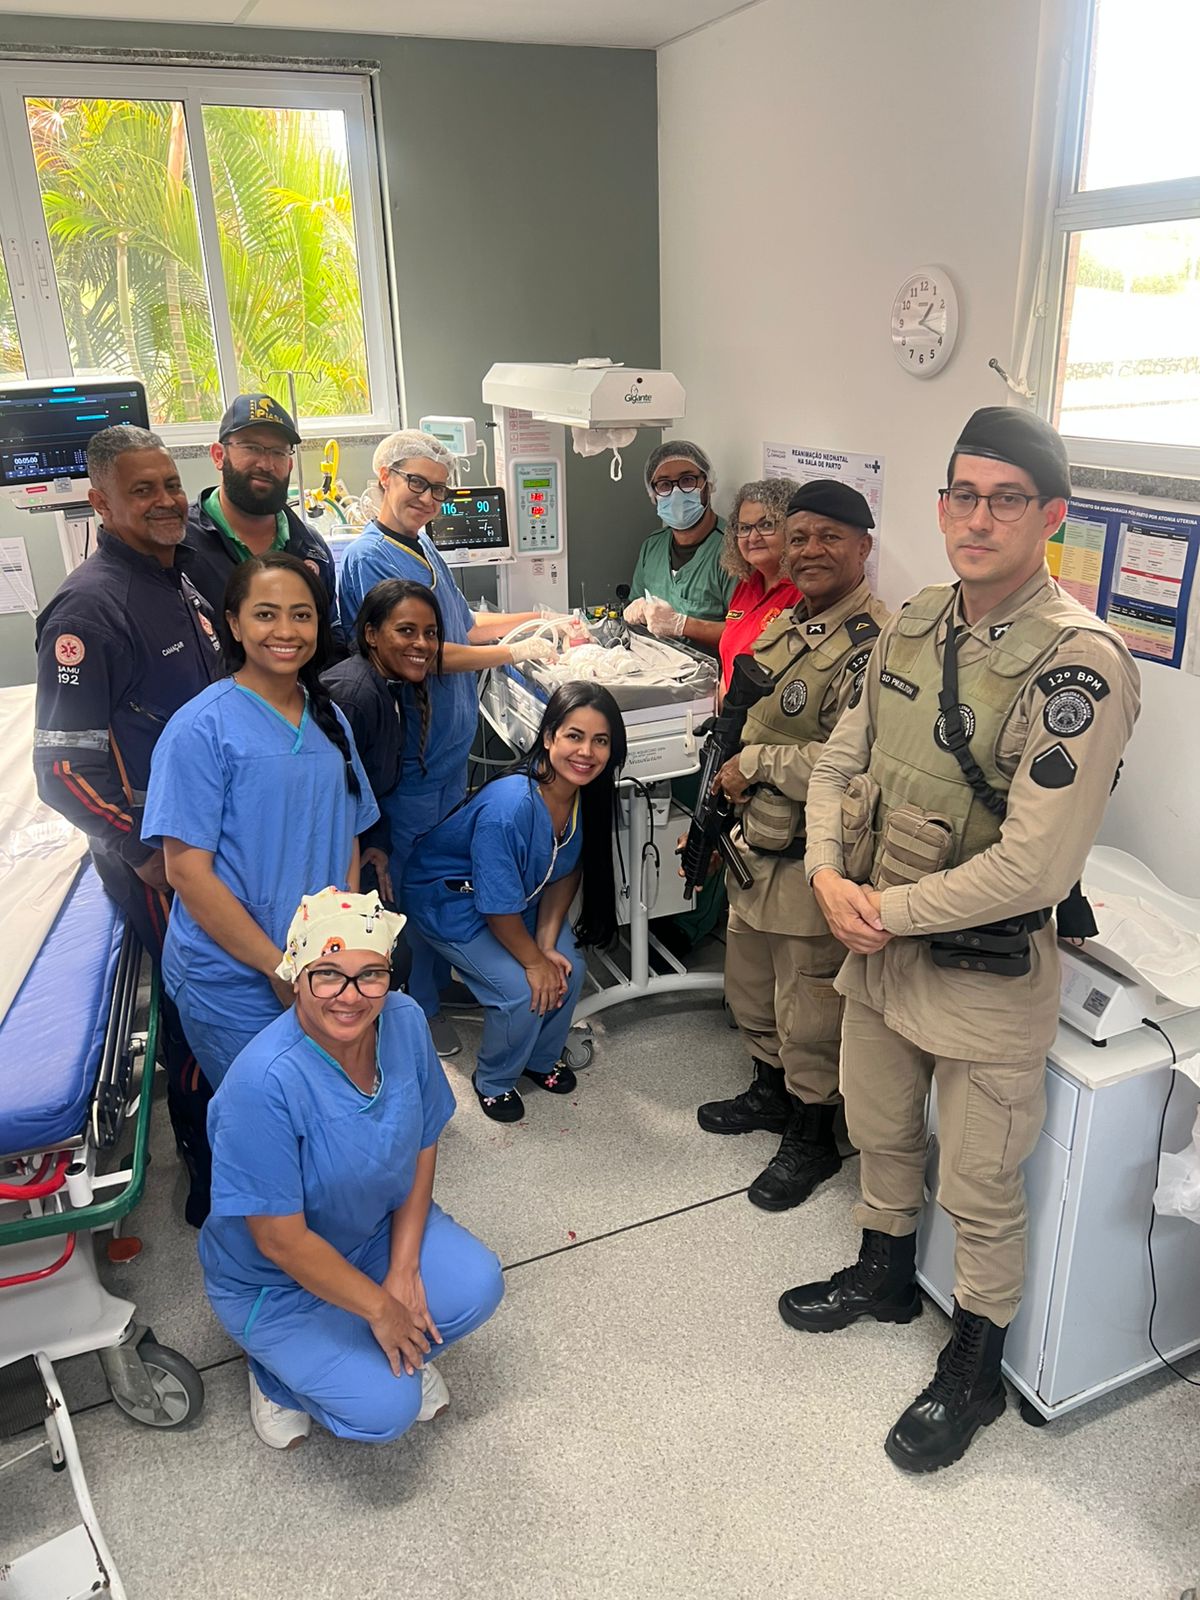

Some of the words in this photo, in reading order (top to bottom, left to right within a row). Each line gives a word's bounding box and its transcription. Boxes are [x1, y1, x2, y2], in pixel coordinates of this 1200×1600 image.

[920, 281, 929, 292] 12
[933, 286, 937, 296] 1
[910, 288, 918, 298] 11
[902, 300, 911, 311] 10
[940, 299, 945, 309] 2
[899, 319, 904, 329] 9
[937, 336, 943, 347] 4
[909, 349, 915, 359] 7
[919, 354, 924, 364] 6
[930, 349, 935, 359] 5
[624, 393, 652, 405] Gigante
[823, 453, 848, 463] NEONATAL
[818, 460, 825, 468] DE
[826, 461, 841, 470] PARTO
[441, 502, 458, 515] 116
[476, 500, 490, 513] 90
[1176, 517, 1198, 526] UTERINA
[57, 673, 80, 685] 192
[881, 674, 891, 683] SD
[1076, 671, 1103, 691] BPM
